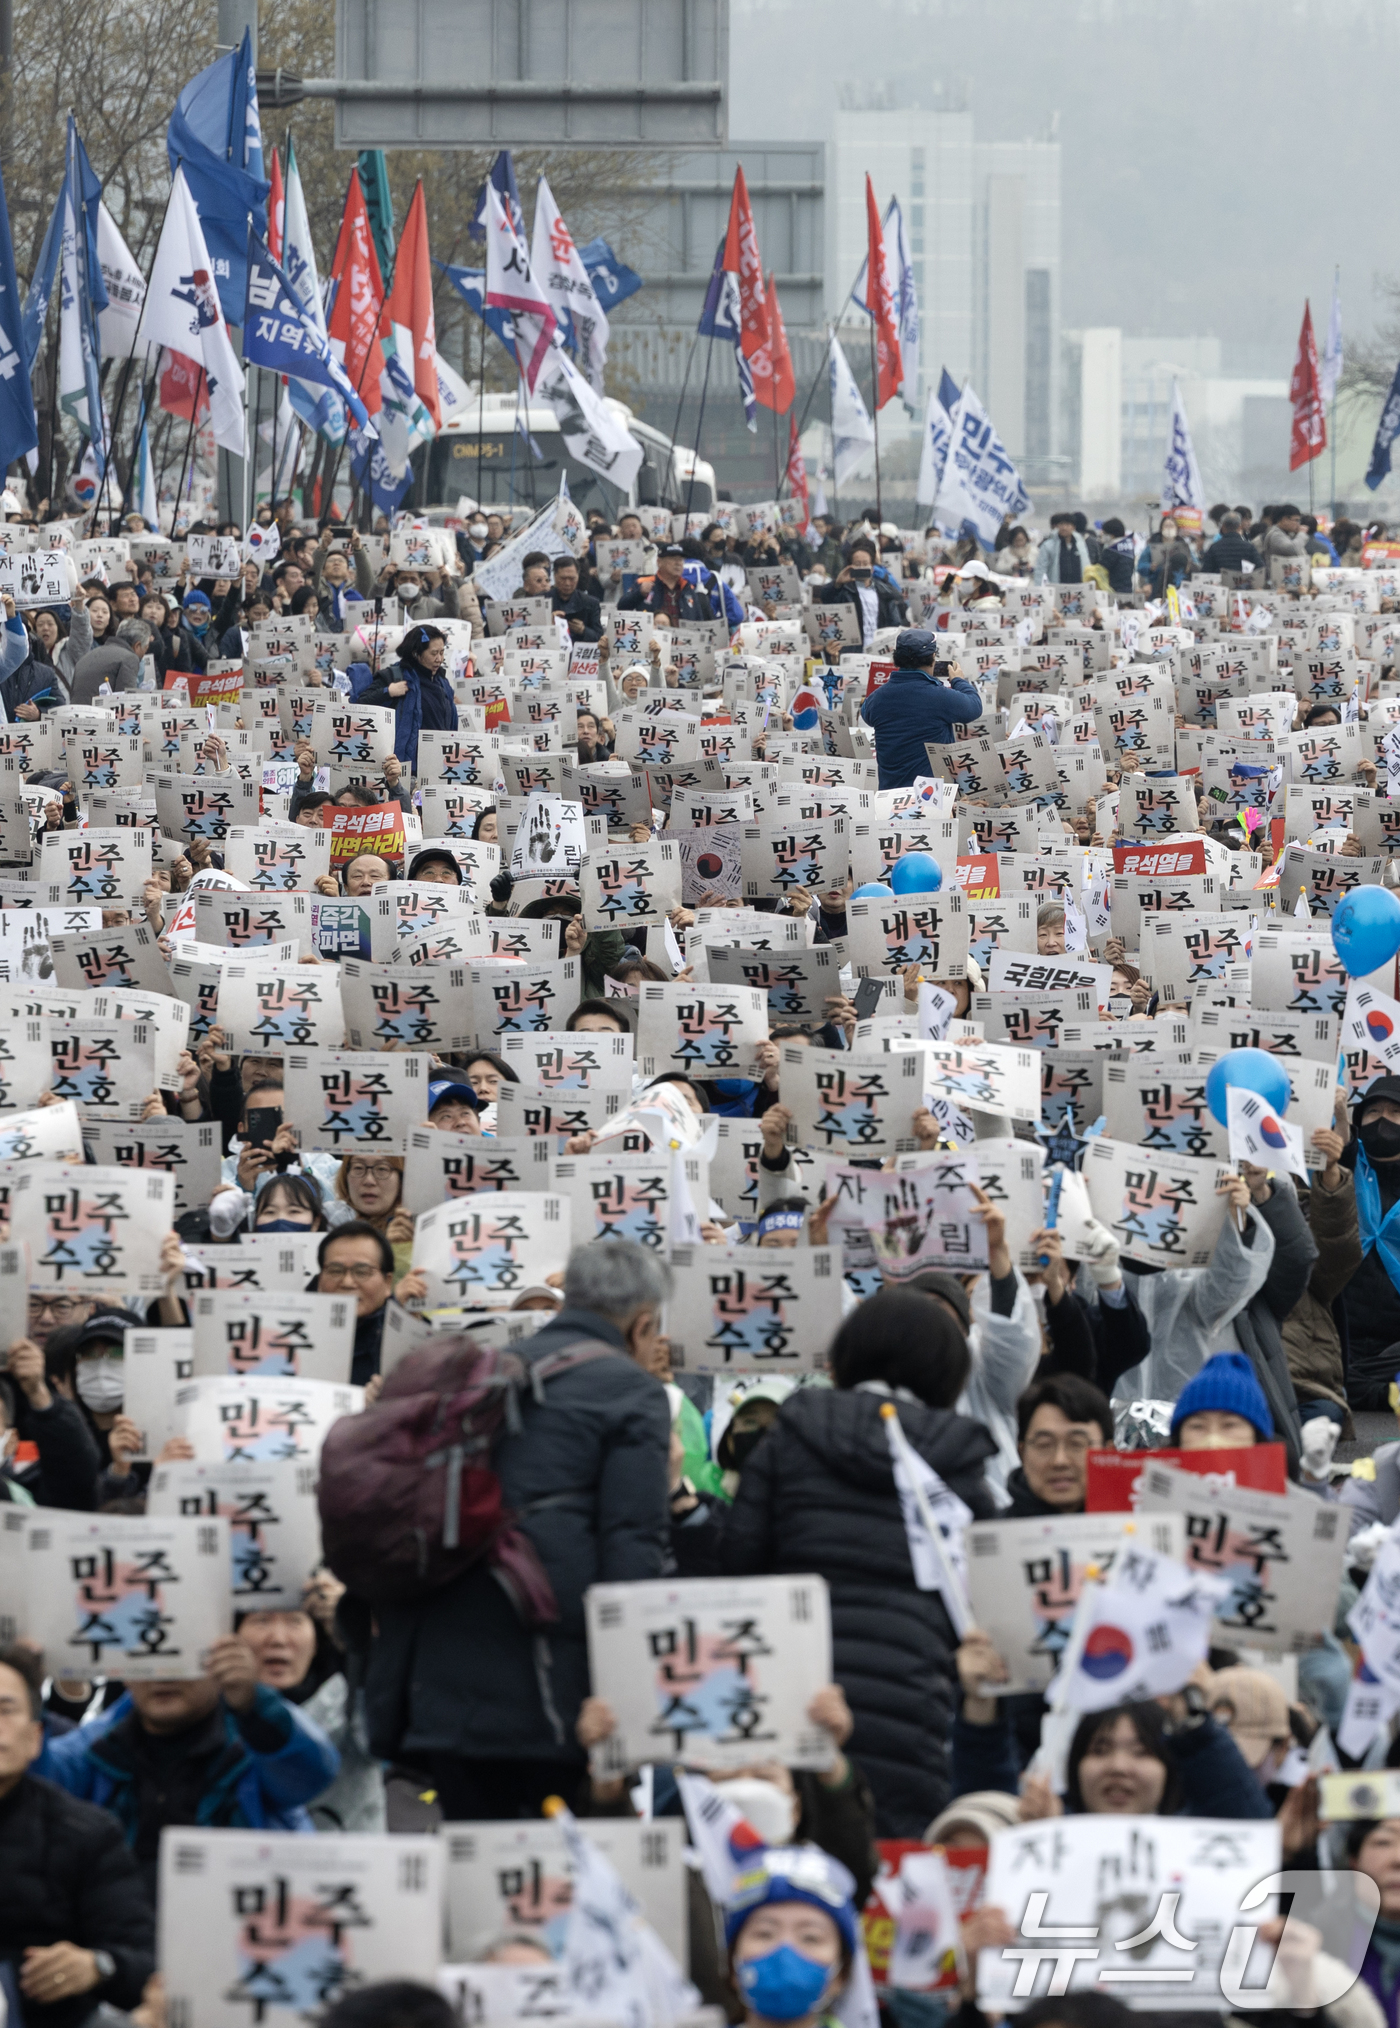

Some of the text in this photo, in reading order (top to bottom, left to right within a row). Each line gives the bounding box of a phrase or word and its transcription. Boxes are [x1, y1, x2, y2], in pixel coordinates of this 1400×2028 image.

[47, 580, 62, 595] 립
[613, 619, 642, 637] 민주
[613, 638, 643, 653] 수호
[521, 657, 553, 674] 민주
[671, 653, 701, 669] 민주
[1217, 660, 1248, 678] 민주
[1308, 662, 1345, 680] 민주
[472, 686, 504, 704] 민주
[1116, 676, 1154, 696] 민주
[1308, 682, 1347, 698] 수호
[332, 715, 378, 734] 민주
[528, 703, 561, 721] 민주
[1109, 709, 1148, 733] 민주
[1238, 708, 1275, 726] 민주
[638, 726, 679, 745] 민주
[701, 736, 735, 754] 민주
[82, 748, 123, 768] 민주
[328, 741, 376, 762] 수호
[441, 742, 485, 763] 민주
[633, 747, 675, 764] 수호
[1298, 738, 1341, 761] 민주
[439, 763, 483, 785] 수호
[515, 767, 556, 788] 민주
[802, 766, 845, 786] 민주
[942, 753, 979, 776] 민주
[1301, 763, 1345, 781] 수호
[182, 790, 234, 815] 민주
[579, 783, 625, 810] 민주
[1135, 789, 1179, 811] 민주
[180, 816, 230, 841] 수호
[332, 812, 394, 833] 윤석열을
[974, 820, 1020, 842] 민주
[1133, 812, 1180, 835] 수호
[68, 842, 124, 869] 민주
[253, 841, 306, 866] 민주
[771, 834, 827, 864] 민주
[596, 859, 654, 890] 민주
[1123, 852, 1194, 874] 윤석열을
[67, 876, 126, 902] 수호
[249, 868, 301, 891] 수호
[770, 864, 826, 891] 수호
[1311, 868, 1361, 893] 민주
[322, 907, 360, 928] 즉각
[396, 892, 448, 918] 민주
[597, 890, 658, 922] 수호
[225, 908, 285, 937] 민주
[882, 907, 944, 941] 내란
[320, 930, 360, 952] 파면
[1184, 928, 1240, 960] 민주
[76, 945, 135, 980] 민주
[742, 963, 808, 990] 민주
[257, 978, 323, 1014] 민주
[371, 981, 440, 1014] 민주
[492, 980, 556, 1012] 민주
[249, 1013, 319, 1047] 수호
[373, 1018, 440, 1045] 수호
[676, 1001, 743, 1036] 민주
[1004, 1007, 1064, 1043] 민주
[51, 1035, 121, 1071] 민주
[535, 1048, 601, 1080] 민주
[671, 1039, 739, 1070] 수호
[51, 1074, 119, 1107] 수호
[320, 1070, 393, 1107] 민주
[815, 1069, 889, 1108] 민주
[318, 1110, 394, 1144] 수호
[814, 1112, 887, 1145] 수호
[443, 1153, 519, 1192] 민주
[591, 1174, 668, 1216] 민주
[1125, 1169, 1198, 1214] 민주
[44, 1189, 129, 1232] 민주
[447, 1213, 528, 1252] 민주
[1112, 1210, 1186, 1254] 수호
[39, 1237, 126, 1280] 수호
[444, 1258, 525, 1297] 수호
[709, 1269, 800, 1312] 민주
[226, 1316, 314, 1363] 민주
[706, 1324, 799, 1361] 수호
[220, 1399, 316, 1438] 민주
[1184, 1512, 1288, 1576] 민주
[70, 1546, 179, 1603] 민주
[233, 1547, 284, 1595] 호
[70, 1611, 180, 1663] 수호
[647, 1618, 776, 1684] 민주
[648, 1690, 780, 1751] 수호
